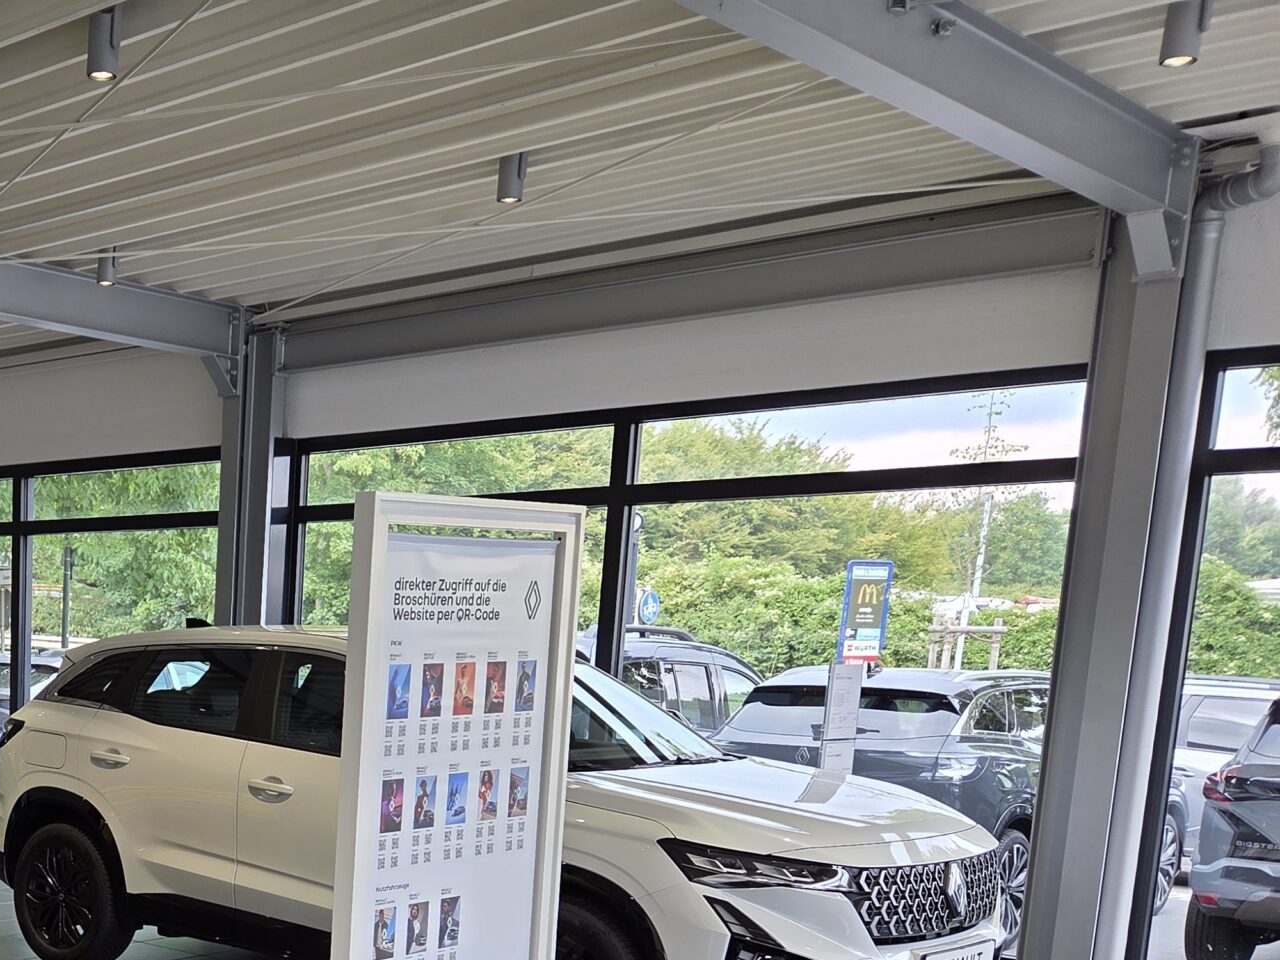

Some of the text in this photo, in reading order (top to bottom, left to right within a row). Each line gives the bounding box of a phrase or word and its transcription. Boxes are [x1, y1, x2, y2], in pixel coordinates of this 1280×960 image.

[394, 577, 507, 595] direkter Zugriff auf die
[393, 592, 491, 607] Broschüren und die
[392, 608, 500, 624] Website per QR-Code
